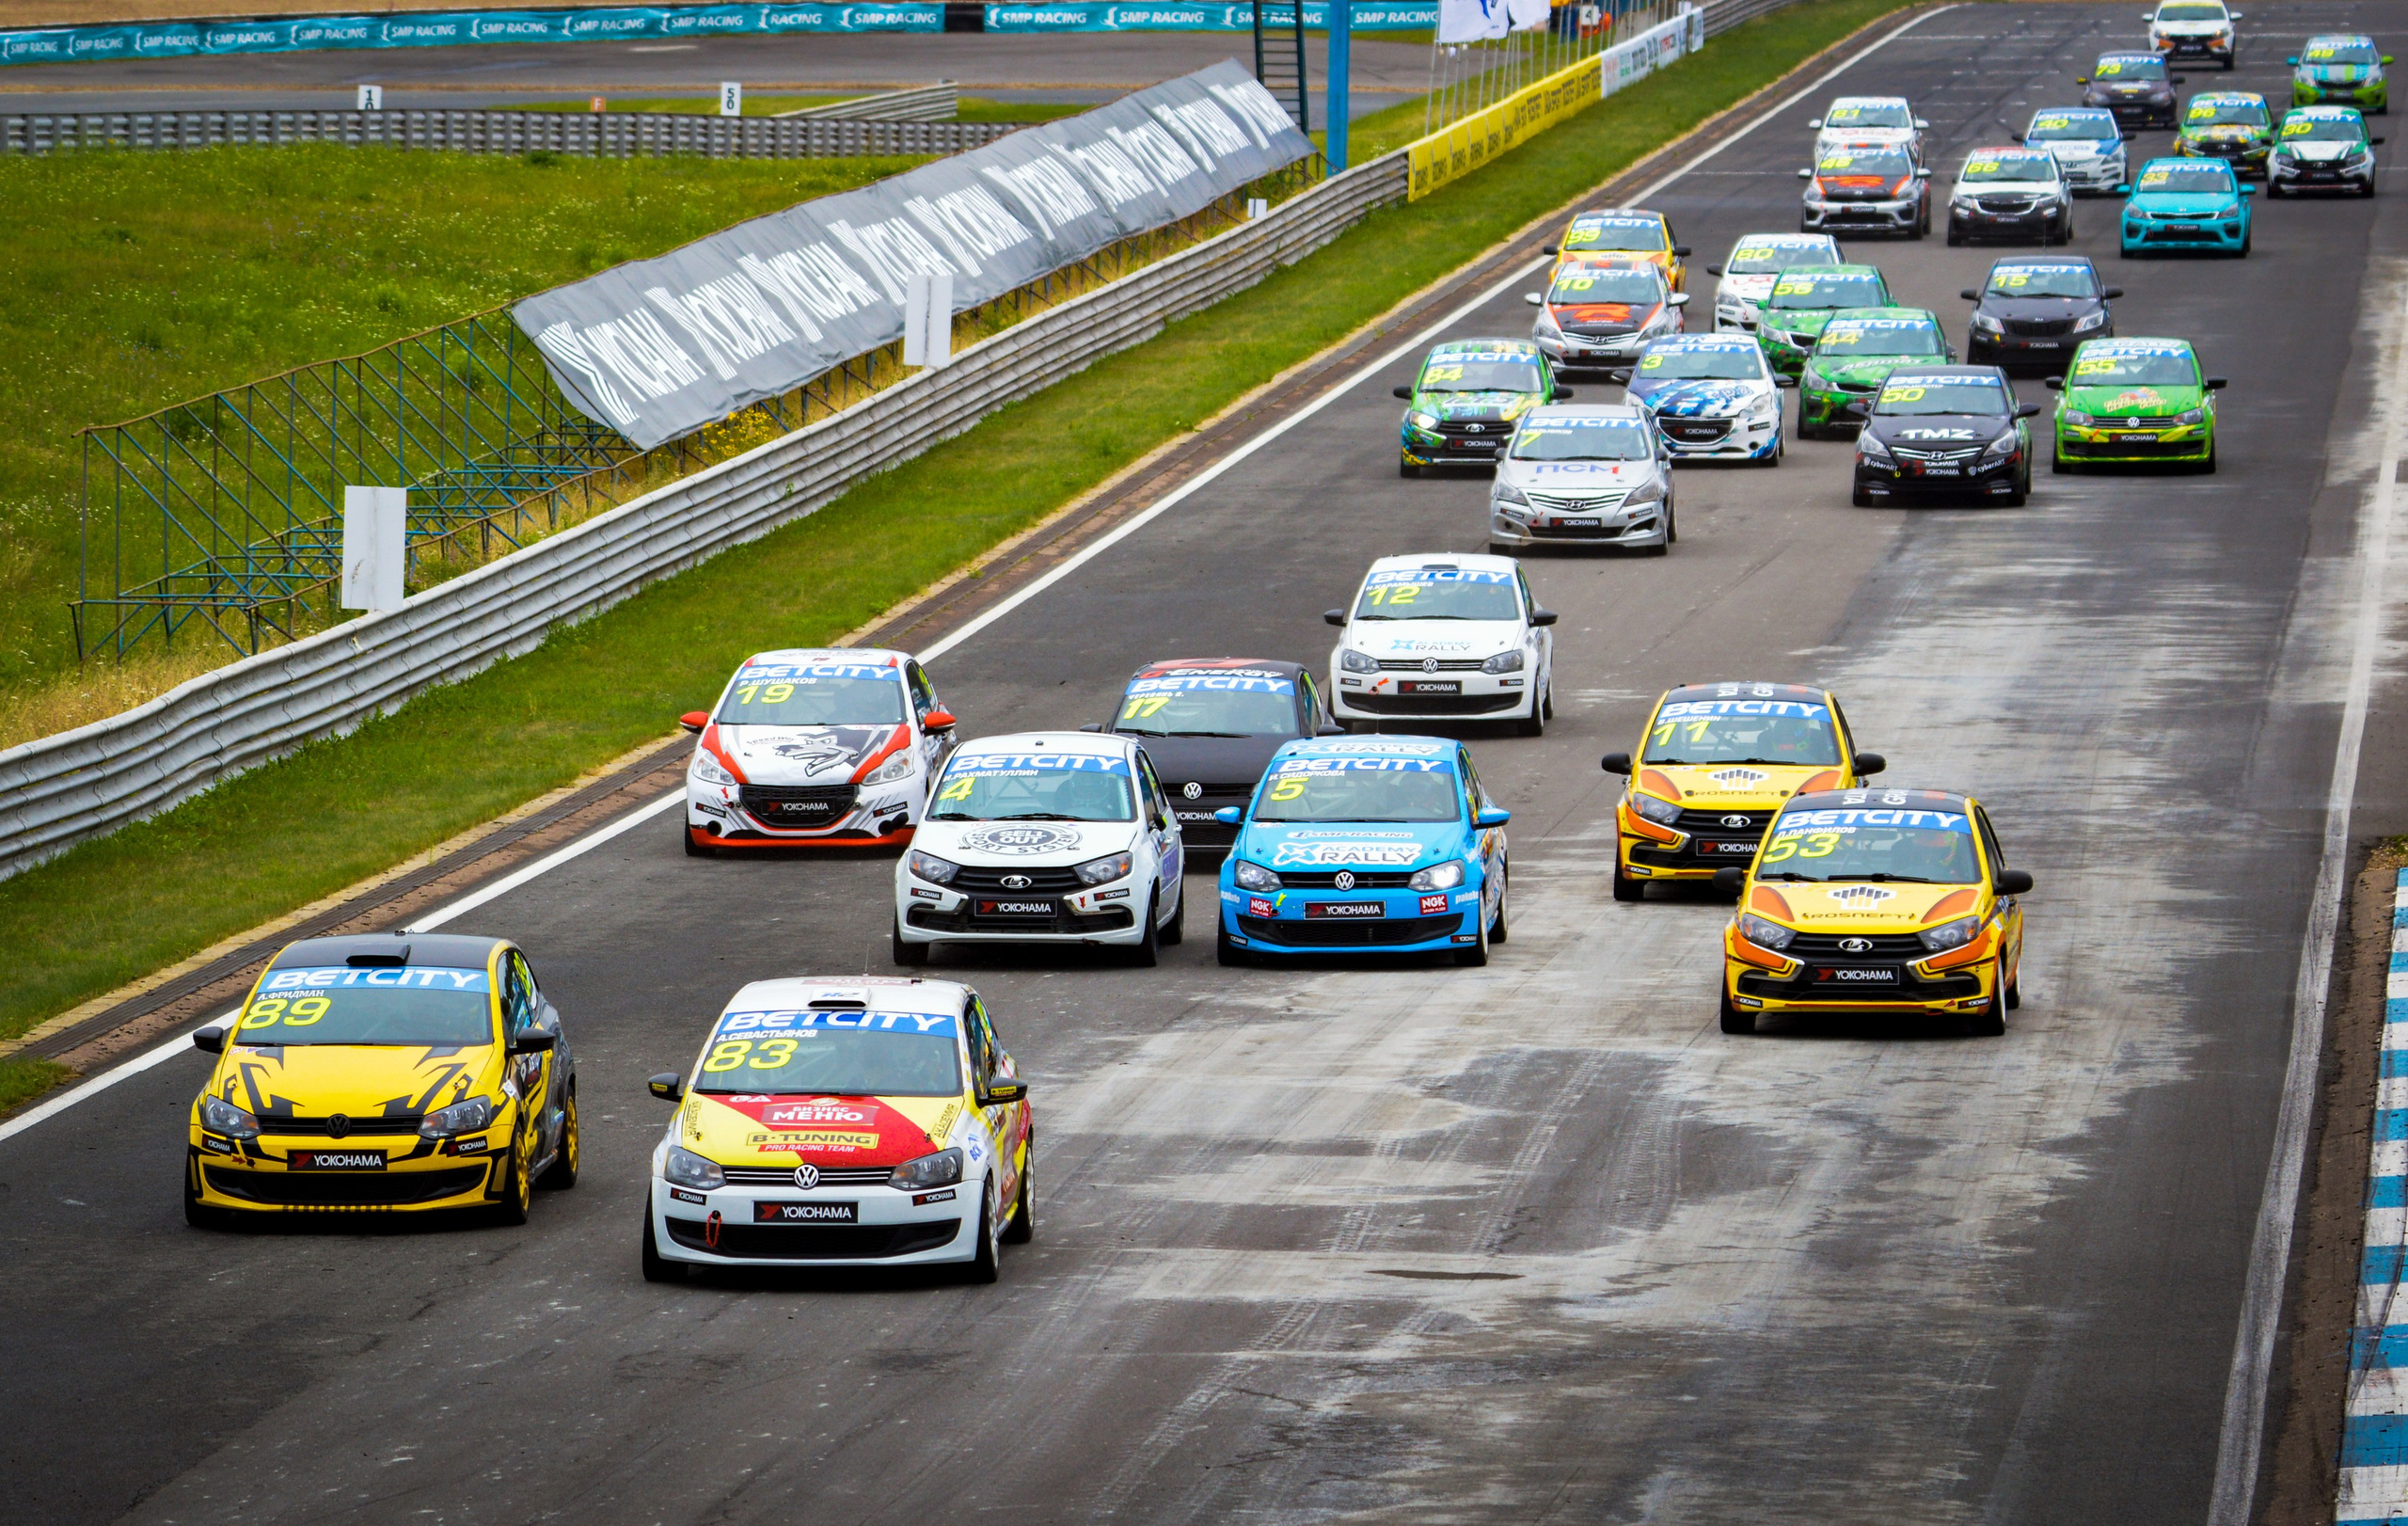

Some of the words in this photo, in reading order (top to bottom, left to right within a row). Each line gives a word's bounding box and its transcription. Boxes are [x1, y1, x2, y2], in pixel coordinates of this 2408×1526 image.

[671, 16, 696, 28] SMP
[698, 15, 743, 27] RACING
[769, 13, 822, 25] RACING
[854, 13, 884, 24] SMP
[885, 12, 937, 24] RACING
[1002, 12, 1032, 24] SMP
[1035, 11, 1087, 24] RACING
[1118, 11, 1149, 24] SMP
[1151, 11, 1204, 24] RACING
[1270, 12, 1323, 24] RACNG
[1355, 12, 1385, 24] SMP
[1387, 11, 1438, 24] RACING
[392, 25, 414, 37] SMP
[416, 24, 456, 36] RACING
[481, 23, 505, 35] SMP
[507, 22, 547, 34] RACING
[573, 20, 599, 32] SMP
[600, 18, 644, 30] RACING
[214, 34, 235, 45] SMP
[238, 32, 275, 43] RACING
[299, 29, 323, 40] SMP
[325, 27, 367, 39] RACING
[144, 36, 164, 47] SMP
[165, 35, 199, 46] RACING
[2095, 63, 2122, 77] 73
[594, 99, 602, 108] F
[2192, 99, 2260, 107] BETCITY
[2189, 107, 2216, 119] 96
[2286, 115, 2356, 123] BETCITY
[2037, 119, 2069, 129] 40
[2281, 122, 2312, 135] 30
[1966, 162, 2000, 174] 66
[1575, 218, 1660, 228] BETCITY
[1567, 230, 1601, 245] 99
[1740, 242, 1830, 250] BETCITY
[1735, 248, 1774, 261] 80
[1560, 269, 1654, 278] BETCITY
[1994, 265, 2088, 274] BETCITY
[1781, 274, 1876, 282] BETCITY
[1994, 276, 2029, 288] 15
[1557, 278, 1594, 291] 10
[1773, 282, 1814, 295] 56
[1830, 320, 1930, 329] BETCITY
[1820, 332, 1859, 346] 44
[1651, 343, 1753, 353] BETCITY
[2080, 347, 2185, 358] BETCITY
[1430, 353, 1535, 363] BETCITY
[1641, 355, 1664, 370] 3
[2076, 359, 2117, 375] 55
[1423, 368, 1464, 384] 84
[1887, 376, 1997, 386] BETCITY
[1882, 389, 1925, 403] 50
[1529, 417, 1643, 428] BETCITY
[1519, 432, 1543, 448] 7
[1903, 429, 1974, 439] TMZ
[1870, 460, 1898, 471] cyberART
[1977, 458, 2005, 472] cyberART
[1563, 518, 1599, 527] YOKOHAMA
[1370, 570, 1511, 584] BETCITY
[1368, 585, 1421, 606] 12
[737, 665, 895, 680] BETCITY
[739, 677, 816, 687] Р.ШУШАКОВ
[1132, 677, 1291, 692] BETCITY
[1416, 683, 1457, 691] YOKOHAMA
[737, 683, 795, 705] 19
[1123, 696, 1170, 720] 17
[1661, 702, 1824, 718] BETCITY
[1654, 721, 1710, 746] 11
[950, 755, 1124, 771] BETCITY
[1279, 758, 1443, 772] BETCITY
[943, 770, 1038, 782] И.РАХМАТУЛЛИН
[1280, 770, 1346, 779] СИДОРКОВА
[940, 777, 976, 801] 4
[1270, 777, 1309, 802] 5
[782, 803, 829, 811] YOKOHAMA
[1177, 812, 1216, 820] YOKOHAM
[1778, 810, 1963, 830] BETCITY
[1719, 844, 1759, 852] YOKOHAM
[1763, 834, 1840, 864] 53
[1321, 852, 1411, 862] RALLY
[917, 889, 941, 899] YOKOHAMA
[1103, 889, 1129, 899] YOKOHAMA
[997, 903, 1052, 913] YOKOHAMA
[1251, 900, 1269, 912] NGK
[1422, 896, 1446, 909] NGK
[1325, 905, 1381, 915] YOKOHAMA
[272, 969, 482, 989] BETCITY
[1836, 970, 1893, 979] YOKOHAMA
[257, 990, 324, 1001] А.ФРИДМАН
[241, 997, 331, 1029] 89
[723, 1011, 947, 1032] BETCITY
[717, 1030, 817, 1041] А.СЕВАСТЬЯНОВ
[704, 1039, 799, 1073] 83
[772, 1111, 863, 1121] МЕНЮ
[934, 1104, 956, 1138] АКАДЕМИЯ
[208, 1139, 230, 1152] YOKOHAMA
[458, 1140, 486, 1152] YOKOHAMA
[314, 1154, 382, 1167] YOKOHAMA
[678, 1192, 704, 1203] YOKOHAMA
[926, 1190, 955, 1202] YOKOHAMA
[782, 1206, 851, 1219] YOKOHAMA
